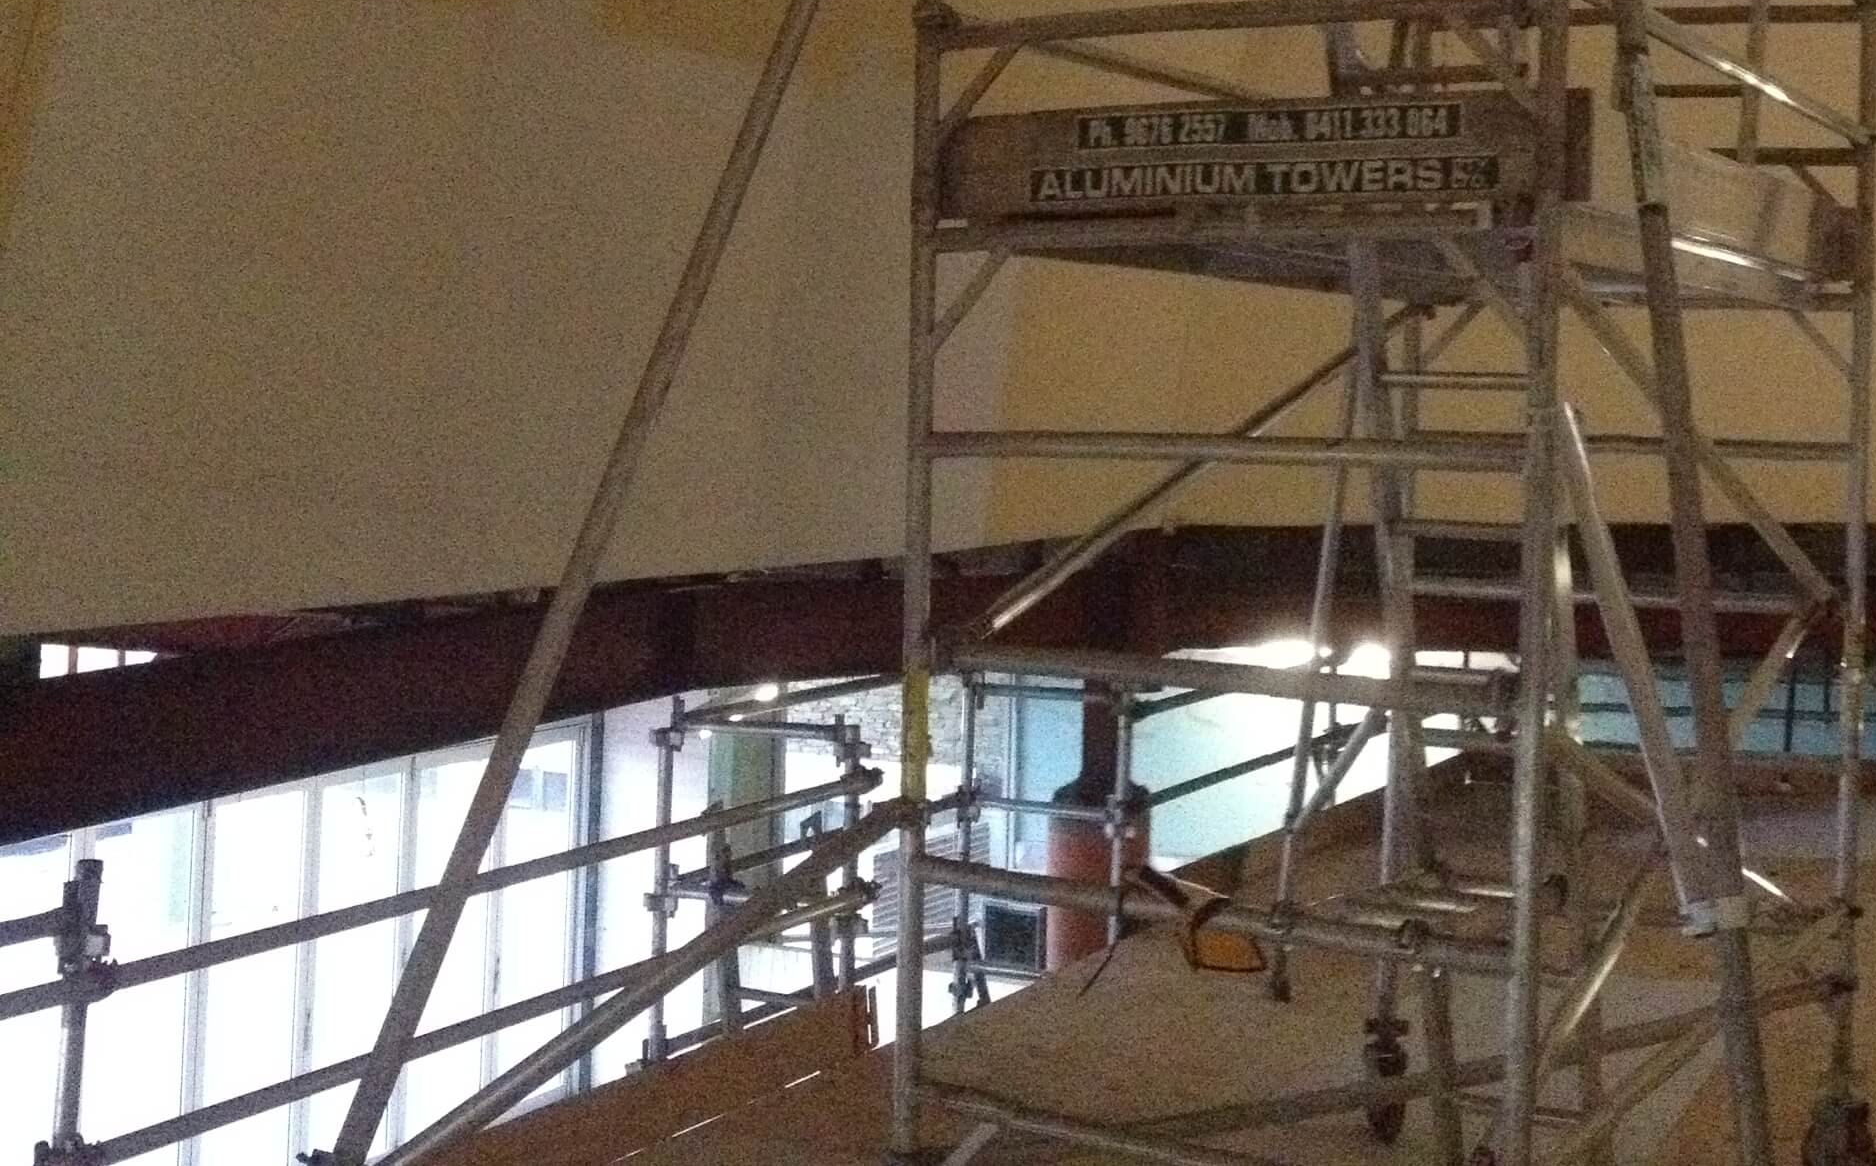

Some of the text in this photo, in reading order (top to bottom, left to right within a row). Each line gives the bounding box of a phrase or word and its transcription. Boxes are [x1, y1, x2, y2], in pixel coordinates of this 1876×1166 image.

[1179, 114, 1226, 142] 2557
[1360, 108, 1400, 137] 333
[1037, 159, 1444, 200] ALUMINIUM TOWERS
